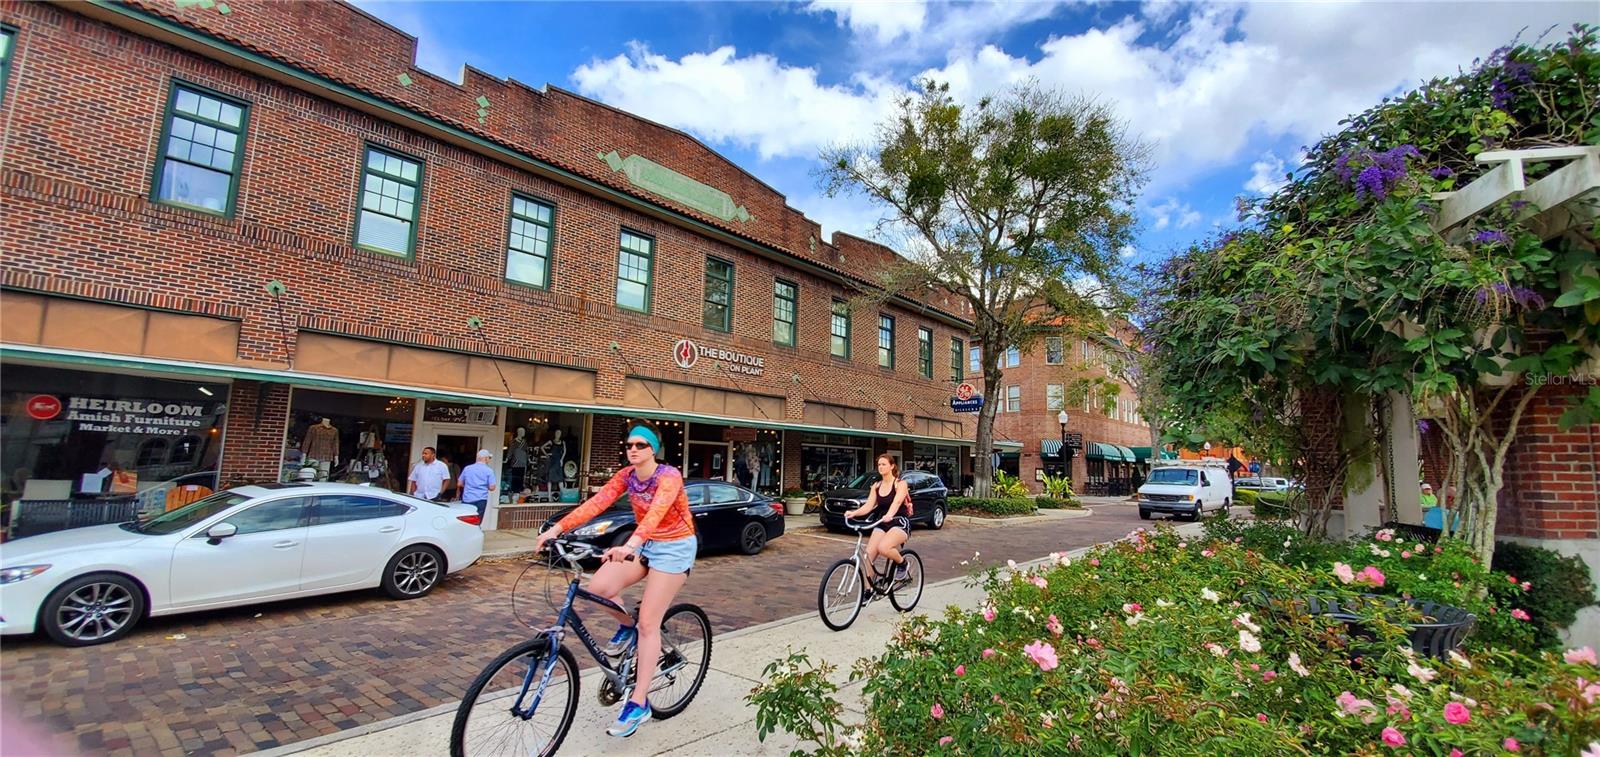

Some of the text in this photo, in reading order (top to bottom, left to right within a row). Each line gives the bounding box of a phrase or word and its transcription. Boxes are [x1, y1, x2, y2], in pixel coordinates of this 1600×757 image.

[698, 346, 765, 367] THE BOUTIQUE
[730, 364, 764, 376] ON PLANT
[69, 397, 202, 416] HEIRLOOM
[67, 411, 201, 427] Amish Furniture
[79, 423, 188, 436] Market & More !
